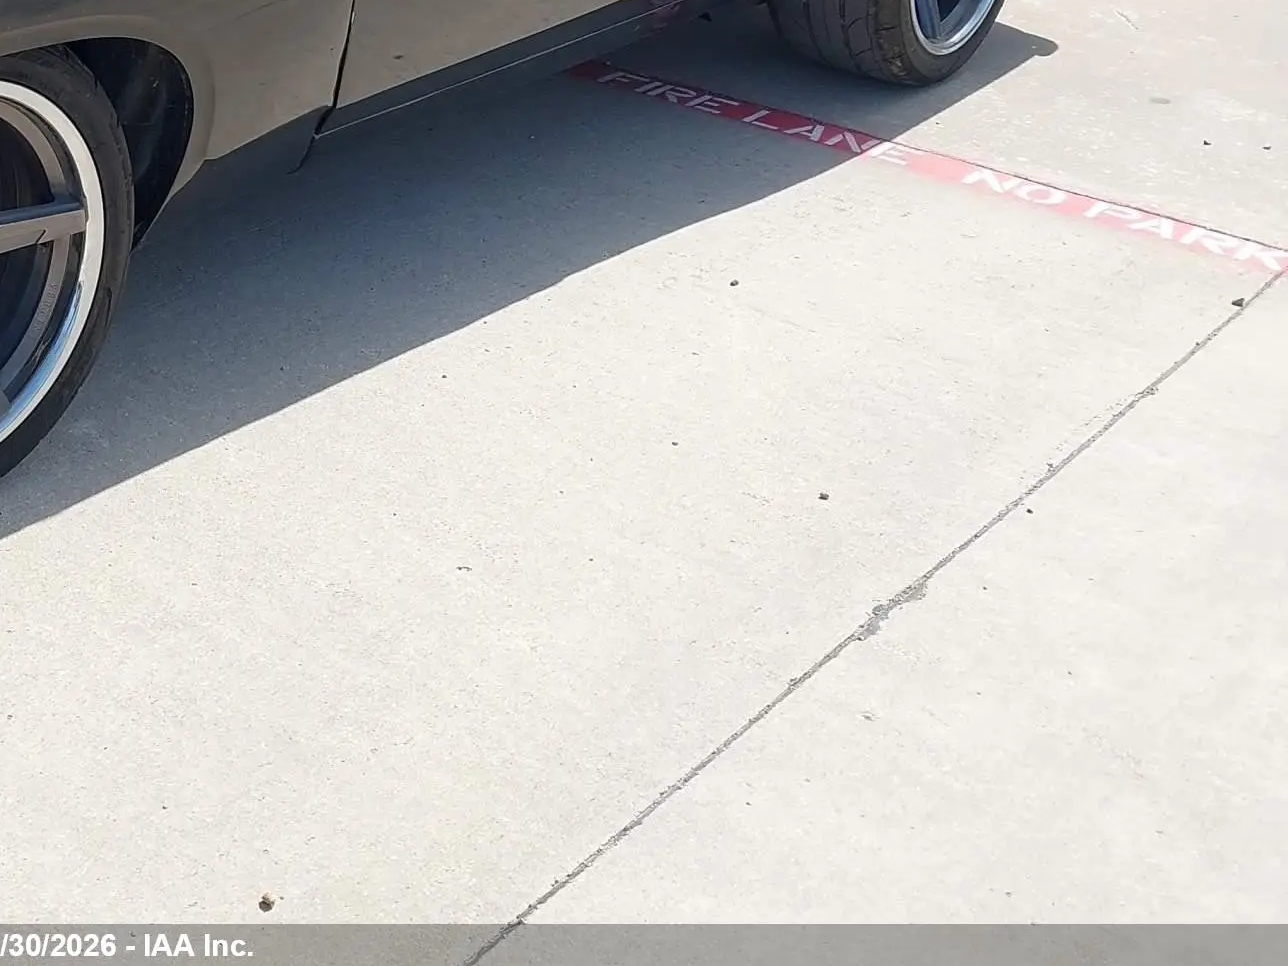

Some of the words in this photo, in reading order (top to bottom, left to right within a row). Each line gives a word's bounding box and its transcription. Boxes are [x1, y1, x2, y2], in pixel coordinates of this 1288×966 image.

[597, 71, 741, 114] FIRE
[743, 109, 909, 166] LANE
[962, 169, 1067, 205] NO
[1084, 202, 1288, 271] PARK
